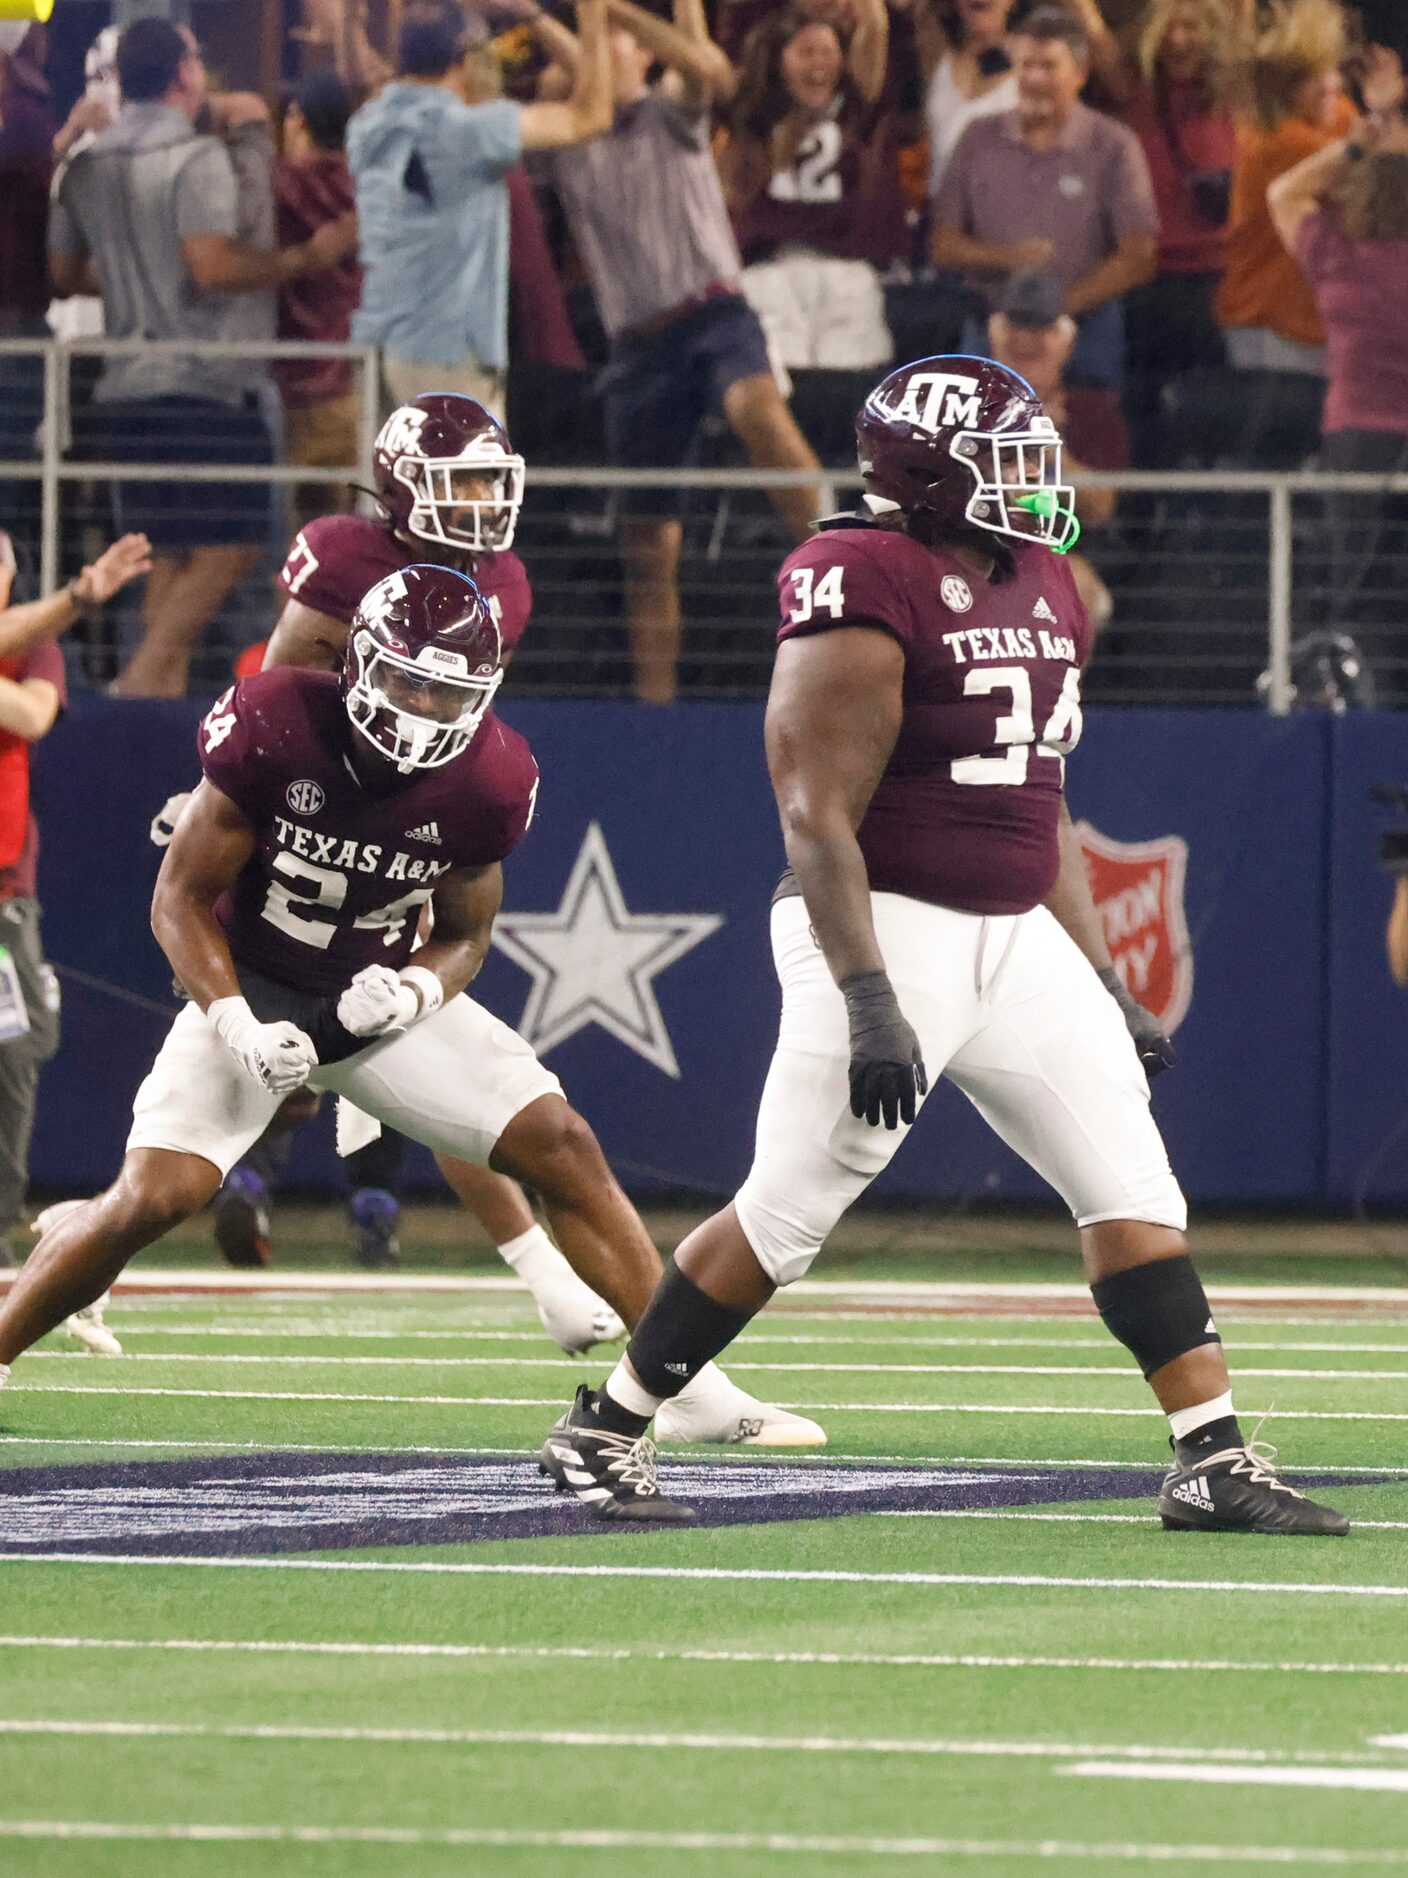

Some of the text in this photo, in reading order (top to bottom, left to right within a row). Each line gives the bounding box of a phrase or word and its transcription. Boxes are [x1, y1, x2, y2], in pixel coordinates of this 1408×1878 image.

[282, 532, 320, 594] 27
[789, 566, 845, 624] 34
[942, 576, 972, 612] SEC
[432, 651, 459, 666] AGGIES
[943, 627, 1077, 664] TEXAS A&M
[950, 666, 1083, 789] 34
[289, 783, 322, 813] SEC
[274, 815, 383, 873] TEXAS
[404, 830, 443, 846] adidas
[260, 850, 436, 954] 24
[1172, 1488, 1215, 1512] adidas
